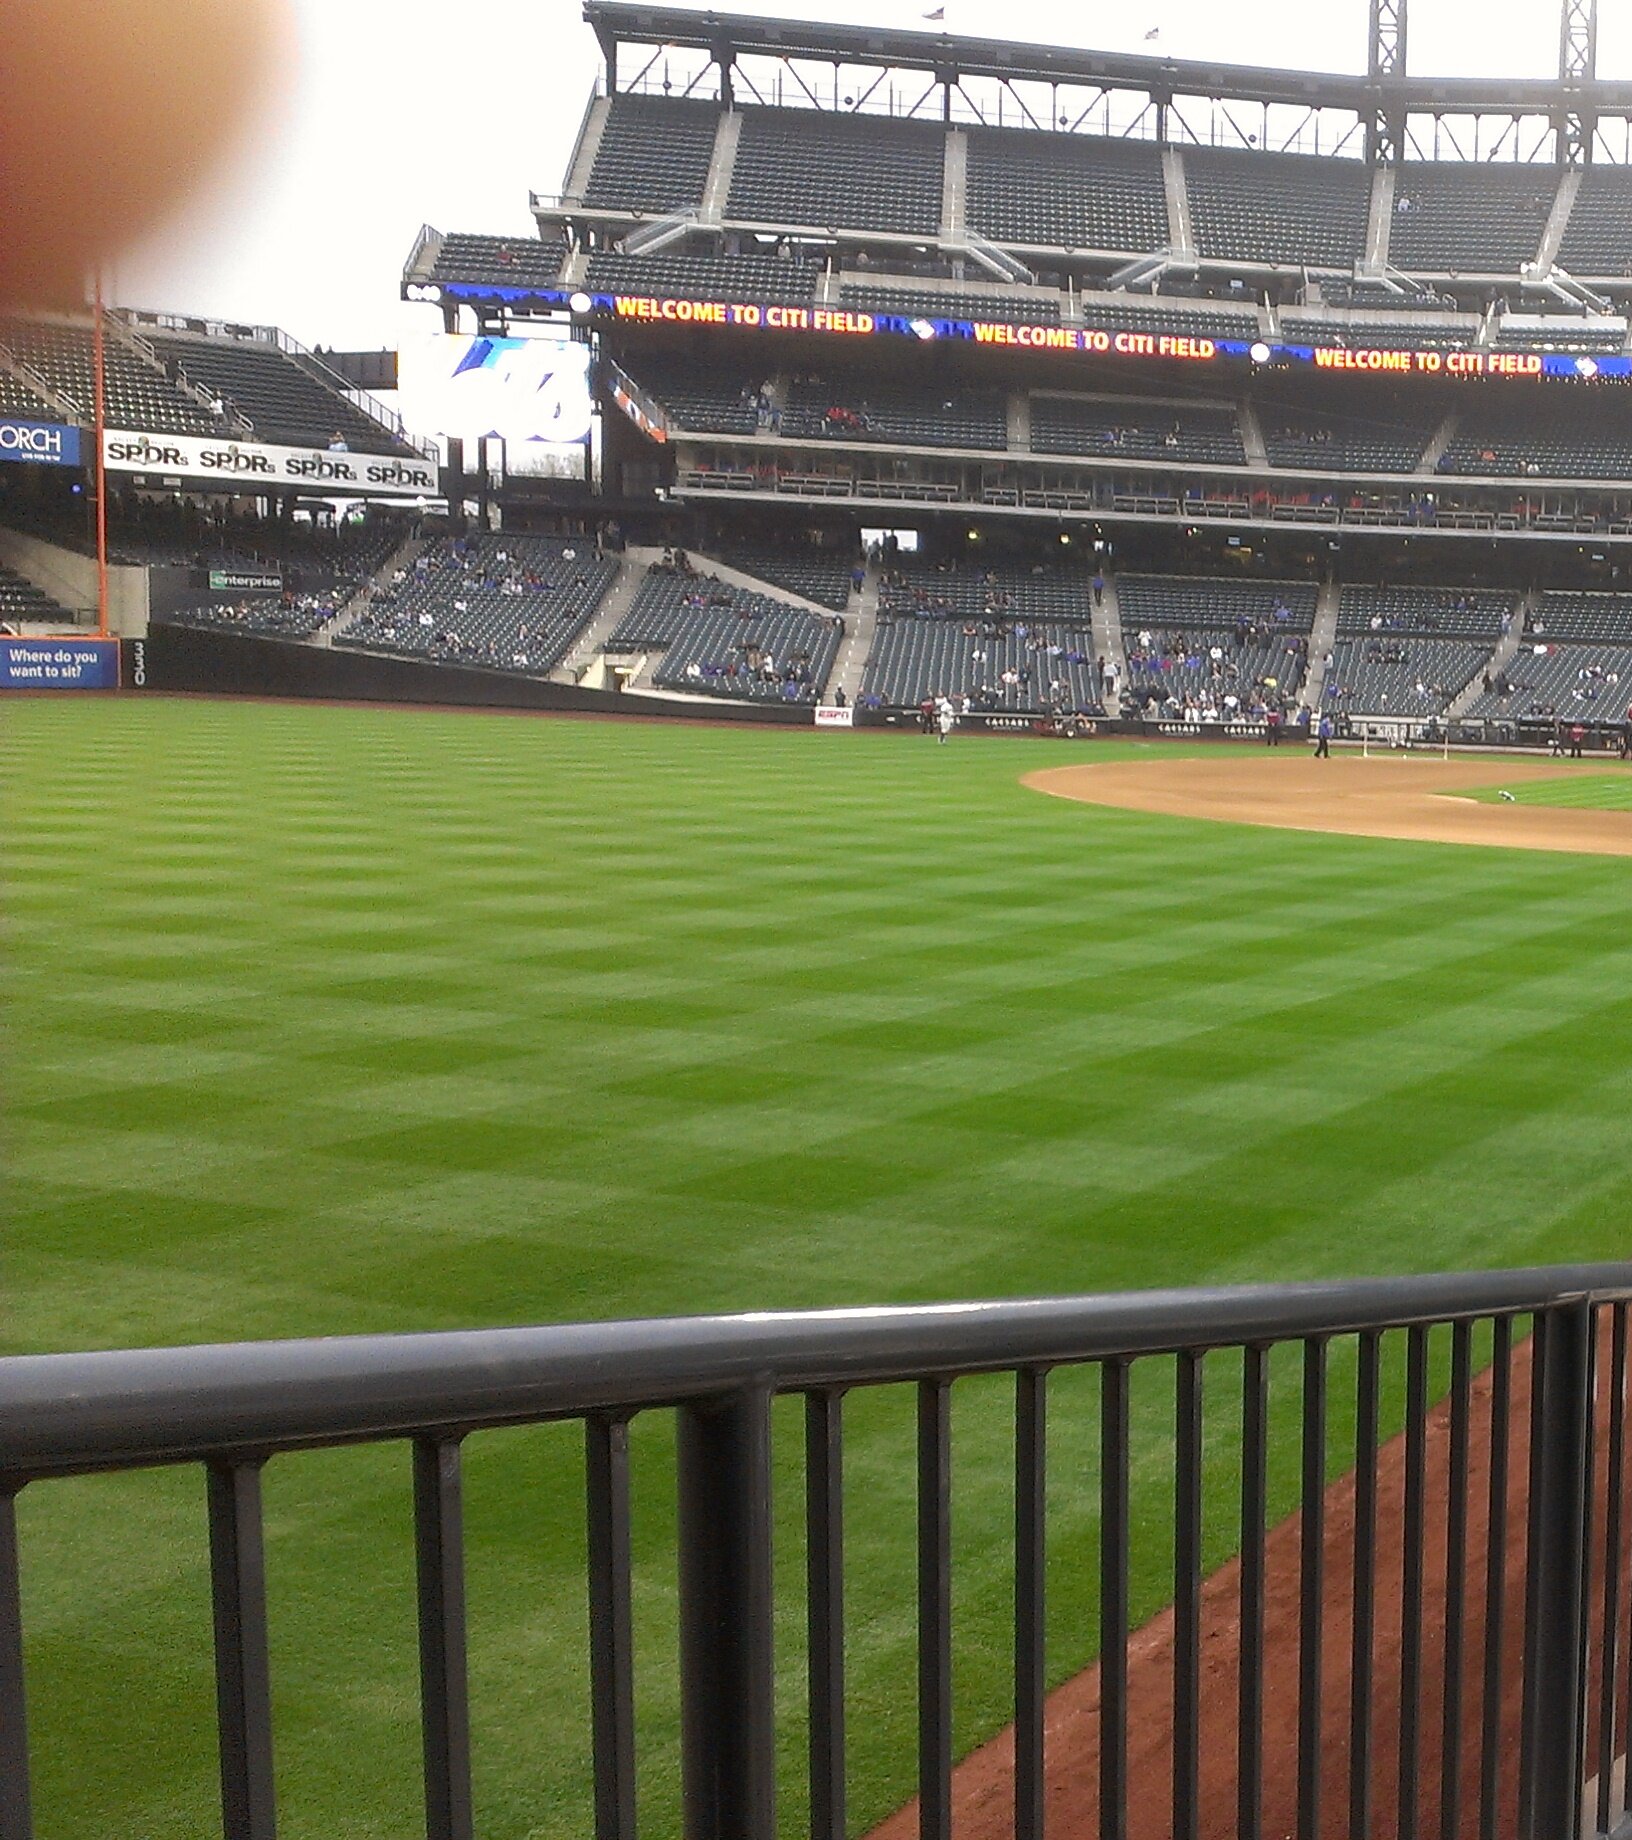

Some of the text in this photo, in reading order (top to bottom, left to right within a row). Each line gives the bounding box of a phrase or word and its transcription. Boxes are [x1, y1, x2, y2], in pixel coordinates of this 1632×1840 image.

[615, 296, 873, 333] WELCOME TO CITI FIELD
[974, 323, 1215, 358] WELCOME TO CITI FIELD
[1315, 348, 1542, 374] WELCOME TO CITI FIELD
[9, 649, 98, 664] Where do you
[134, 641, 146, 686] 330
[9, 665, 82, 678] want to sit?
[818, 710, 850, 719] ESPN
